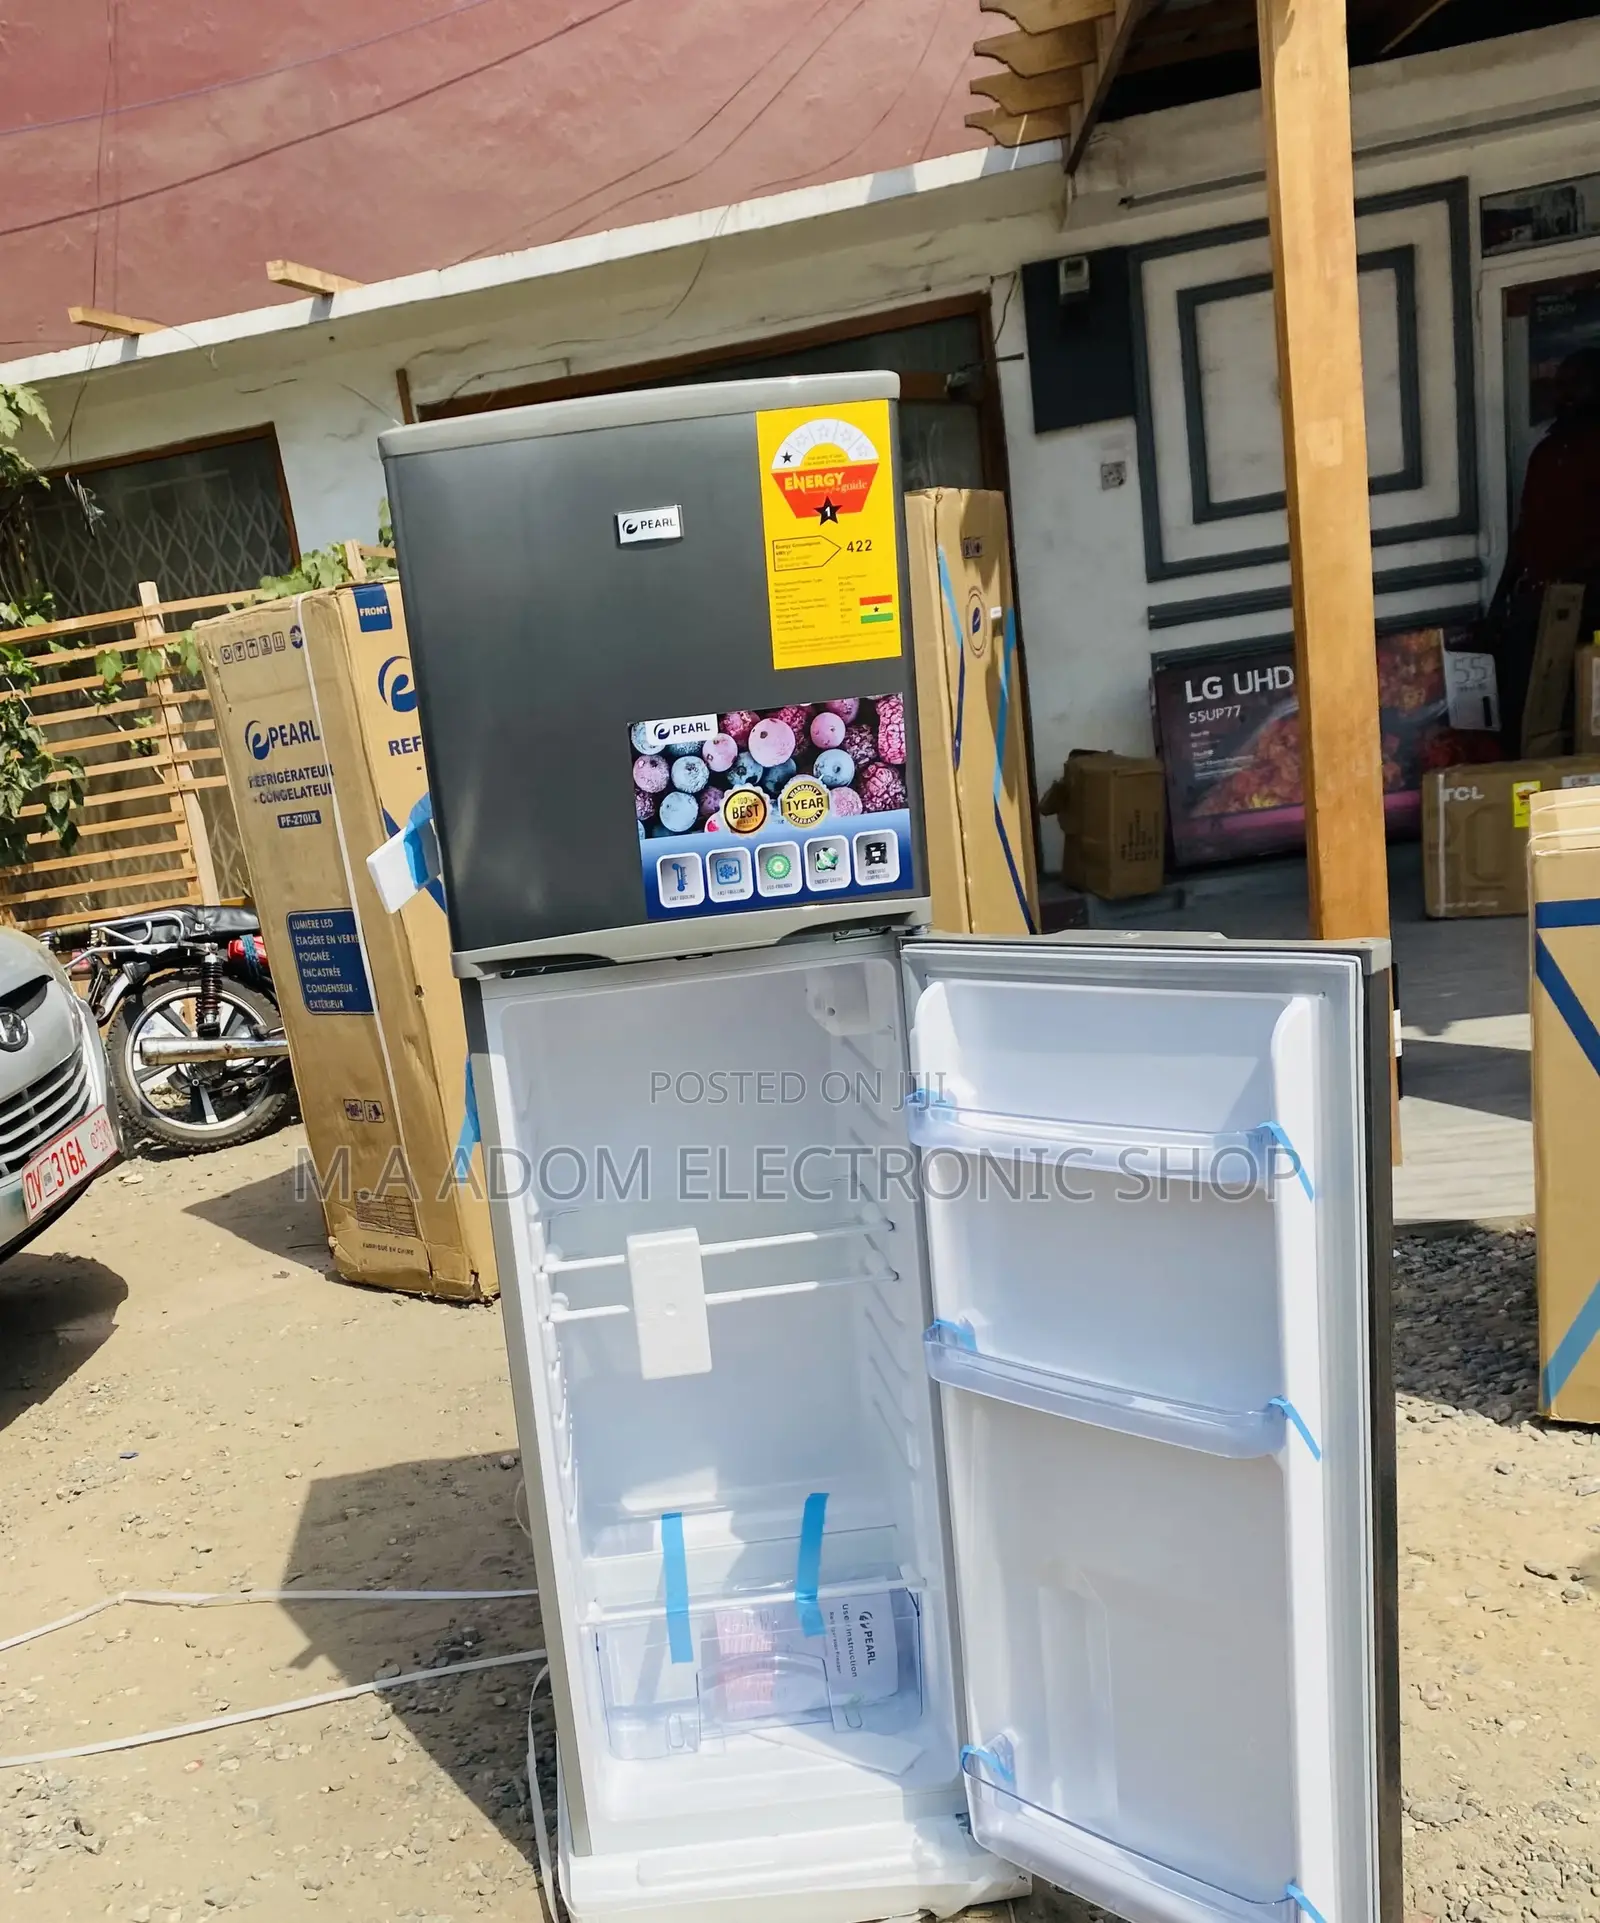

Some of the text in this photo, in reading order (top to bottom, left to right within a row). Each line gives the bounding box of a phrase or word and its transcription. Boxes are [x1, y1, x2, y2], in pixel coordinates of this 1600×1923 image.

[784, 472, 845, 492] ENERGY
[841, 480, 868, 493] guide
[825, 507, 831, 517] 1
[640, 518, 676, 530] PEARL
[847, 539, 872, 553] 422
[359, 605, 388, 617] FRONT
[1185, 665, 1294, 703] LG UHD
[1189, 704, 1241, 724] 55UP77
[269, 720, 320, 749] PEARL
[672, 722, 710, 736] PEARL
[388, 735, 422, 756] REF
[790, 784, 822, 798] WARRANTY
[1442, 785, 1485, 802] TCL
[786, 797, 824, 811] 1 YEAR
[732, 804, 760, 820] BEST
[790, 810, 822, 825] WARRANTY
[280, 812, 318, 827] PF-270IX
[320, 918, 333, 928] LED
[327, 935, 336, 944] EN
[337, 935, 359, 945] VERRE
[299, 949, 331, 962] POIGNÉE
[303, 965, 341, 978] ENCASTRÉE
[306, 983, 353, 994] CONDENSEUR
[25, 1136, 88, 1210] DV 316A
[846, 1628, 858, 1678] Instruction
[864, 1631, 877, 1666] PEARL
